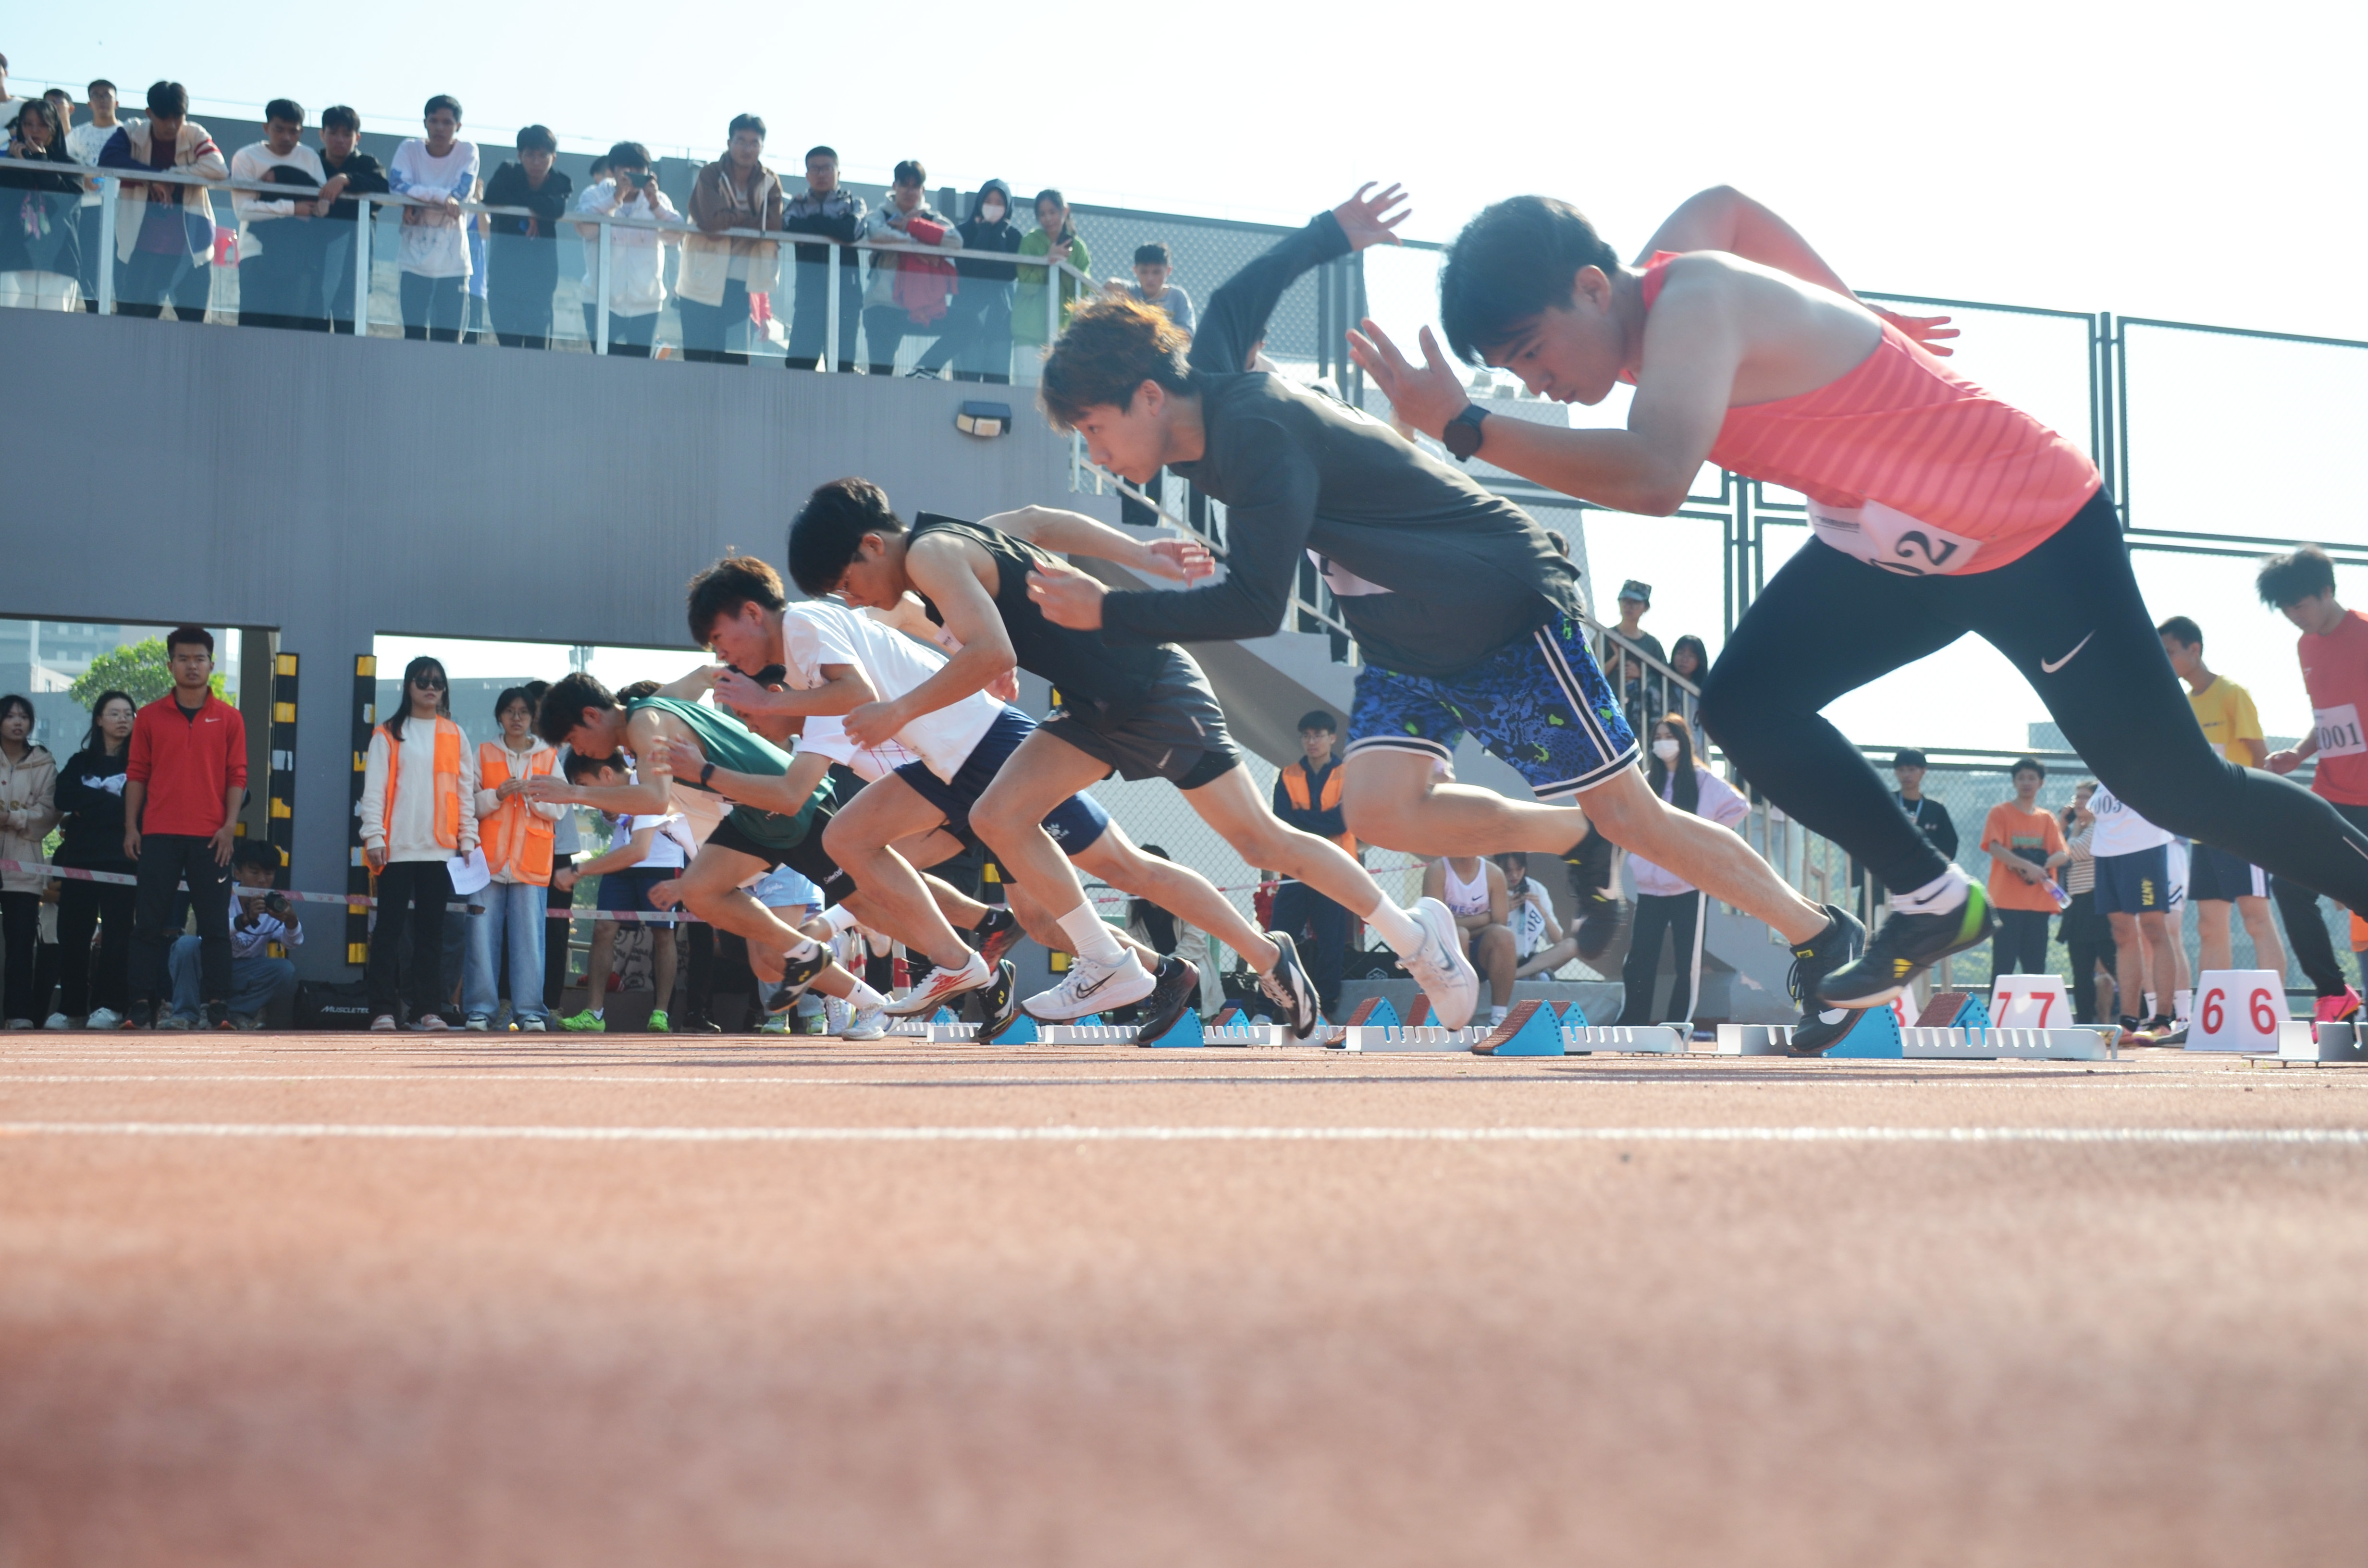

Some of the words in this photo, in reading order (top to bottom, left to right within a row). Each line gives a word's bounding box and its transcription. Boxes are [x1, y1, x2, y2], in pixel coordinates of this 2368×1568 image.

[2141, 878, 2155, 906] ANTA
[1997, 992, 2012, 1028] 7
[2030, 992, 2055, 1028] 7
[2202, 988, 2225, 1035] 6
[2250, 988, 2276, 1035] 6
